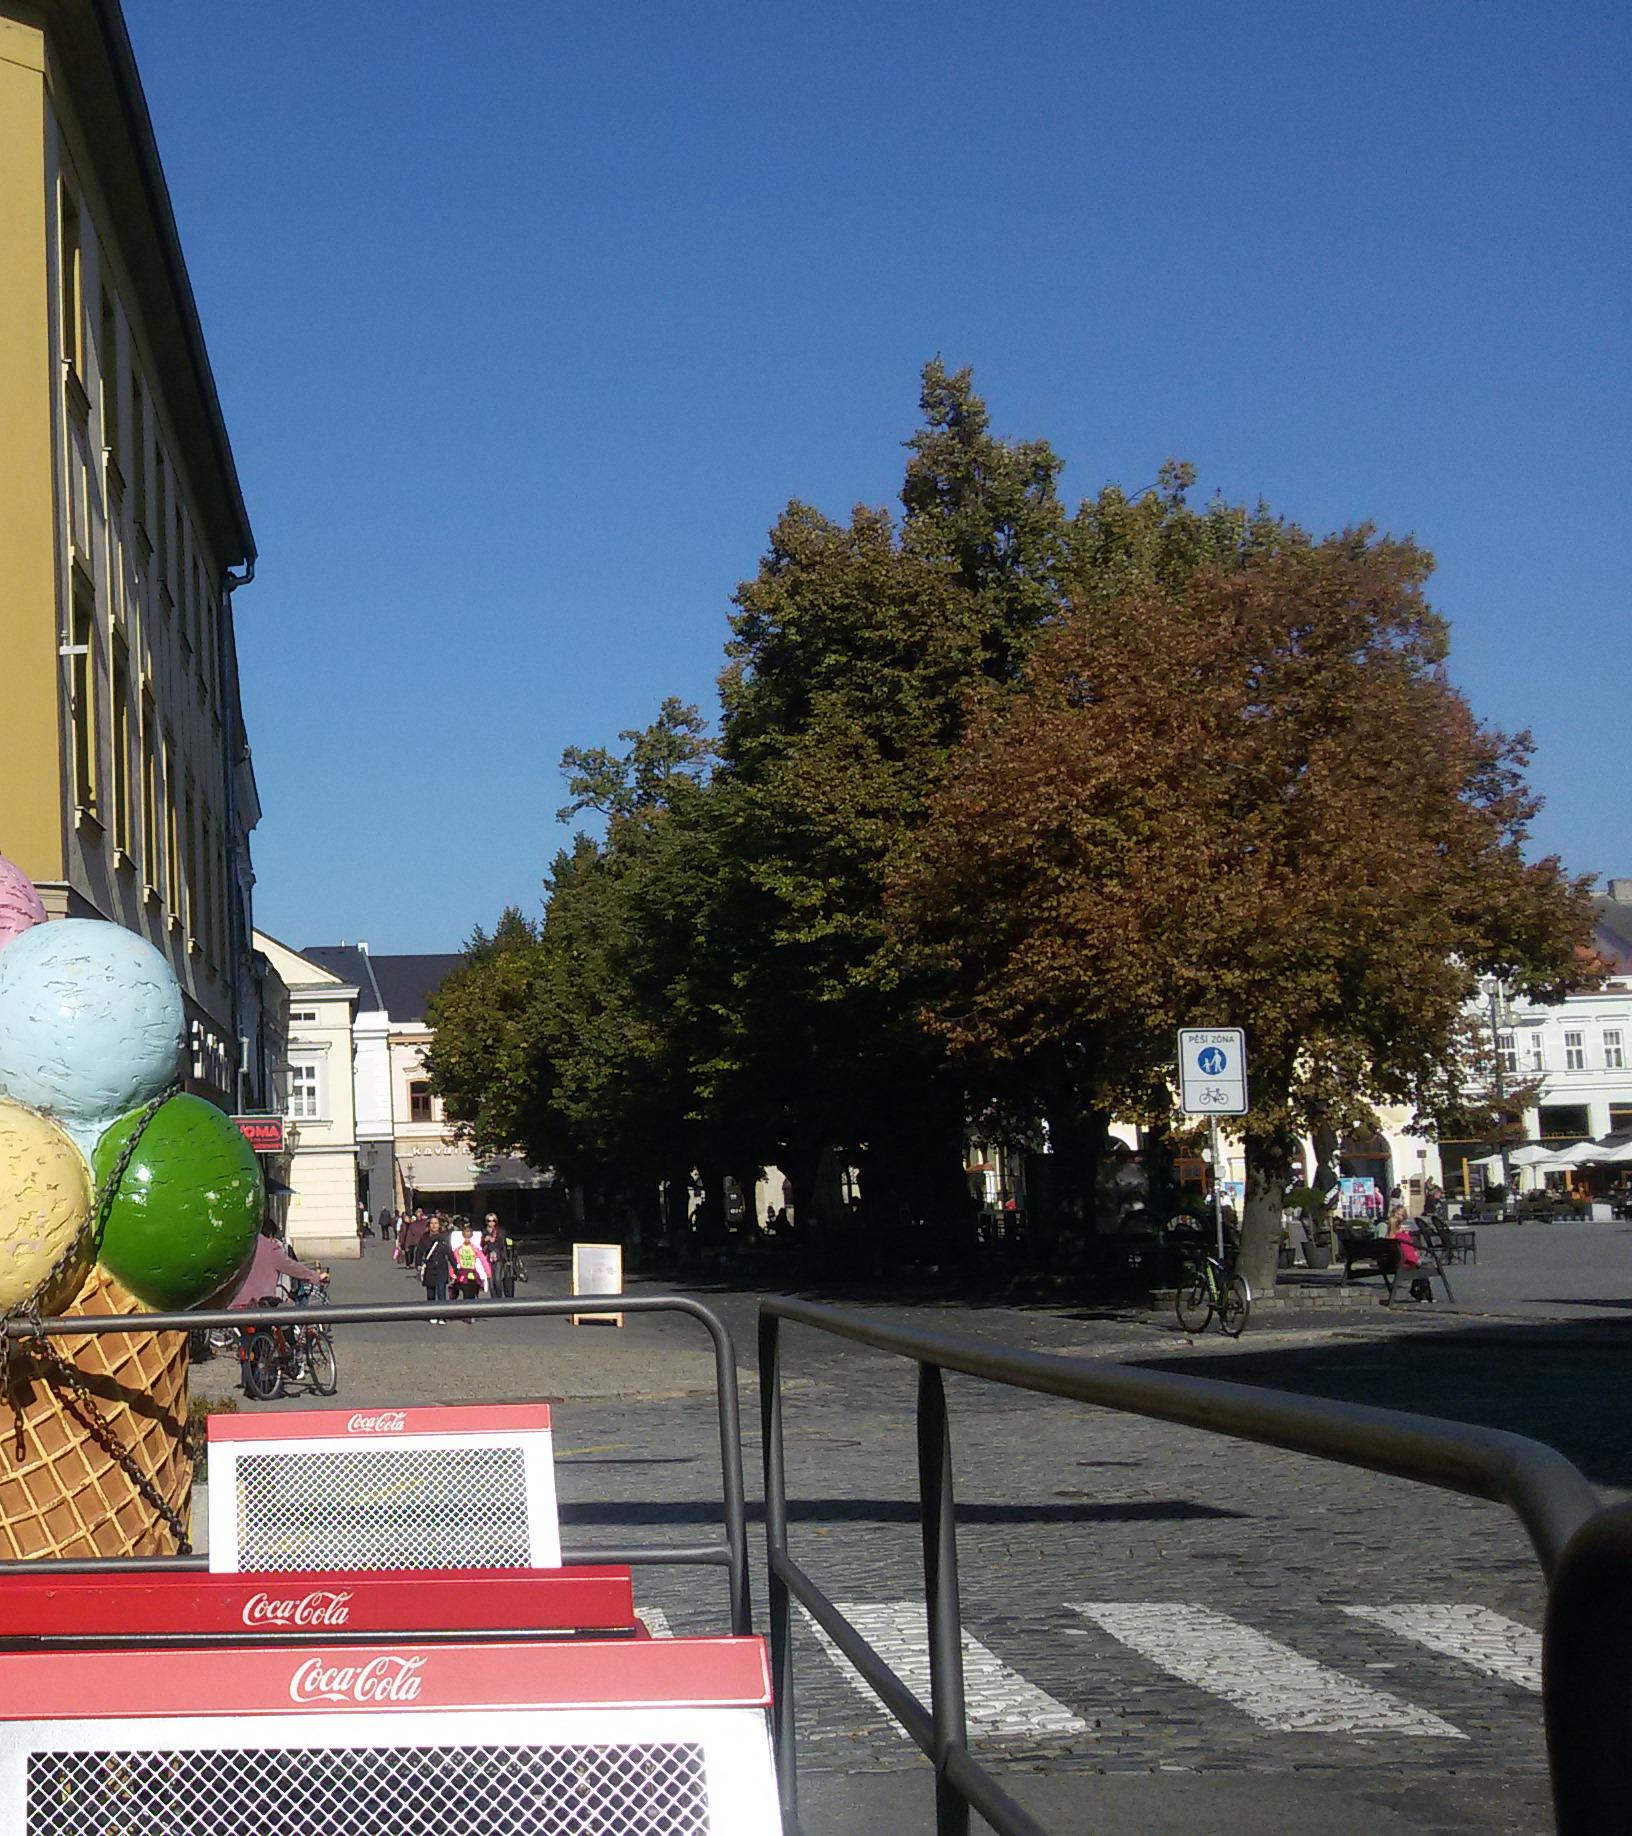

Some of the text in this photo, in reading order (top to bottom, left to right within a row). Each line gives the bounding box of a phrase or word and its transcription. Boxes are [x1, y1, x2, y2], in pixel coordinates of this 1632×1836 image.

[347, 1412, 407, 1433] Coca-Cola
[242, 1591, 355, 1627] Coca-Cola
[289, 1655, 429, 1703] Coca-Cola
